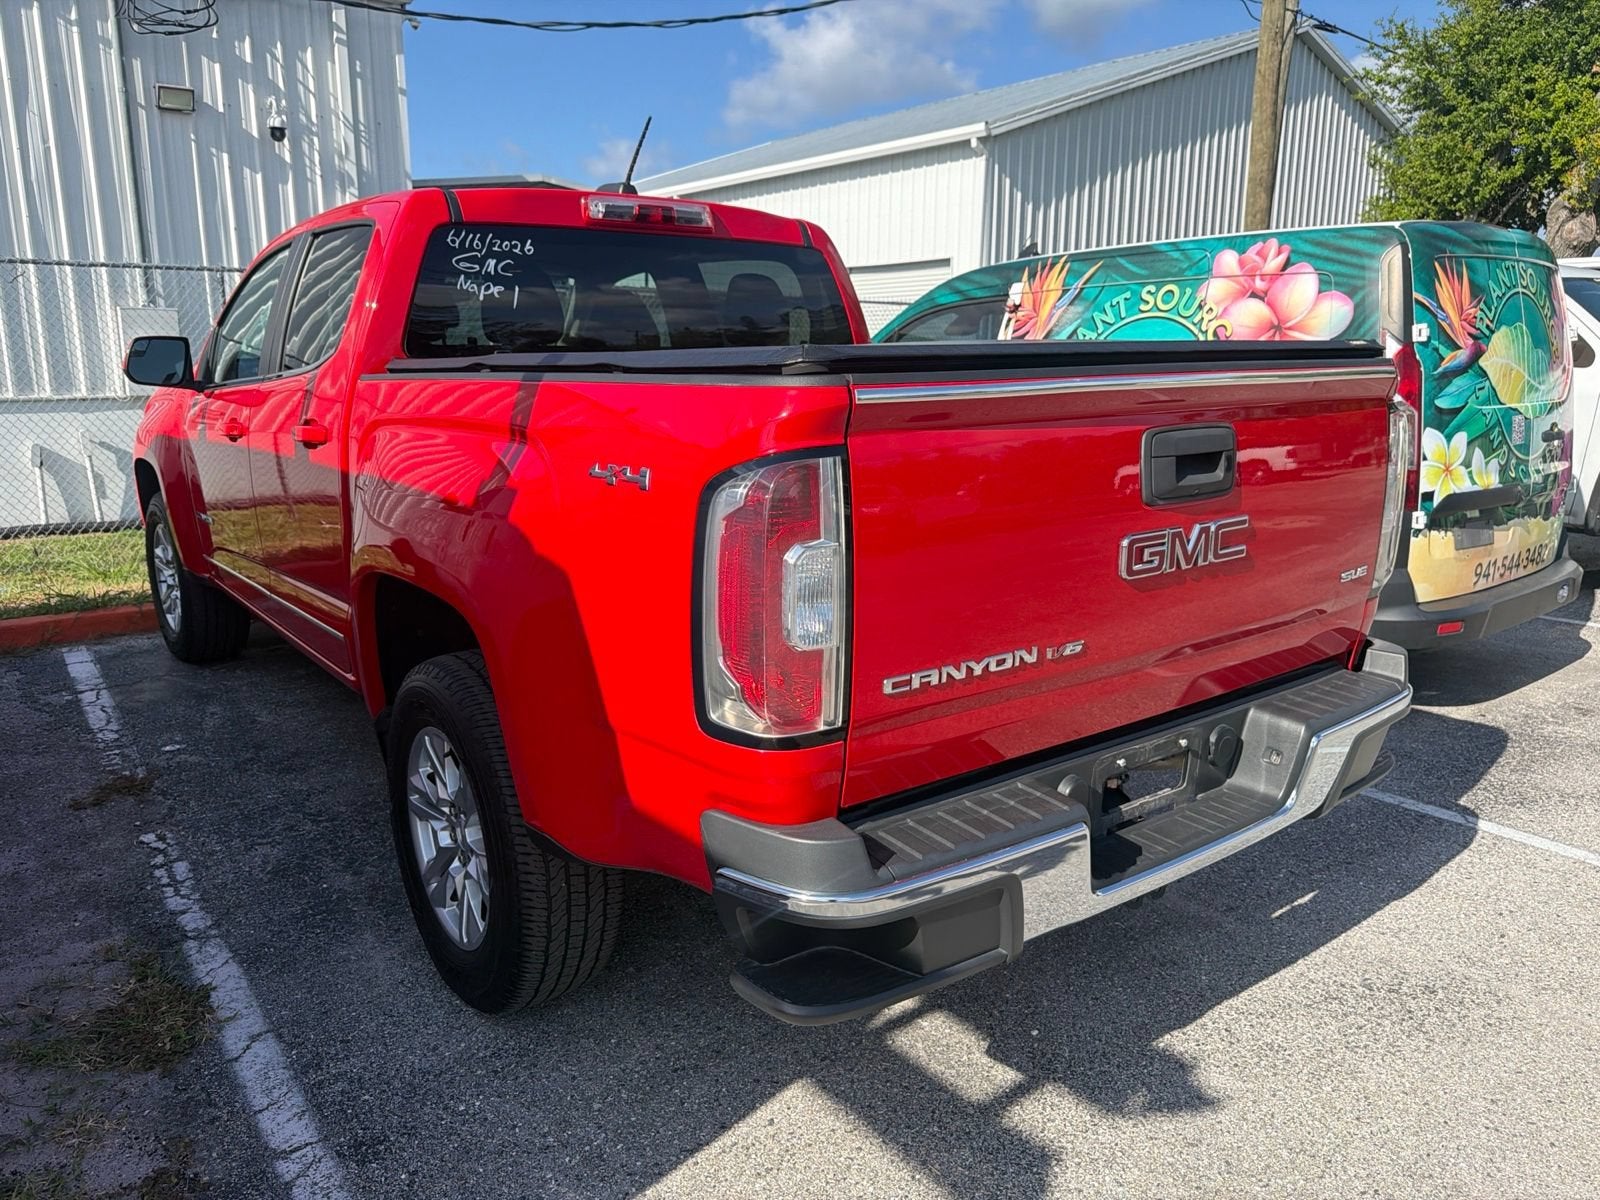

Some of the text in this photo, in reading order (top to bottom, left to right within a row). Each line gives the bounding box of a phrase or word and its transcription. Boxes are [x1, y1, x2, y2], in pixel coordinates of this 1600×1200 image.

[446, 228, 535, 256] 6/16/2026
[452, 251, 515, 277] GMC
[1475, 261, 1517, 336] PLANT
[1118, 514, 1249, 581] GMC
[882, 639, 1085, 695] CANYON V6
